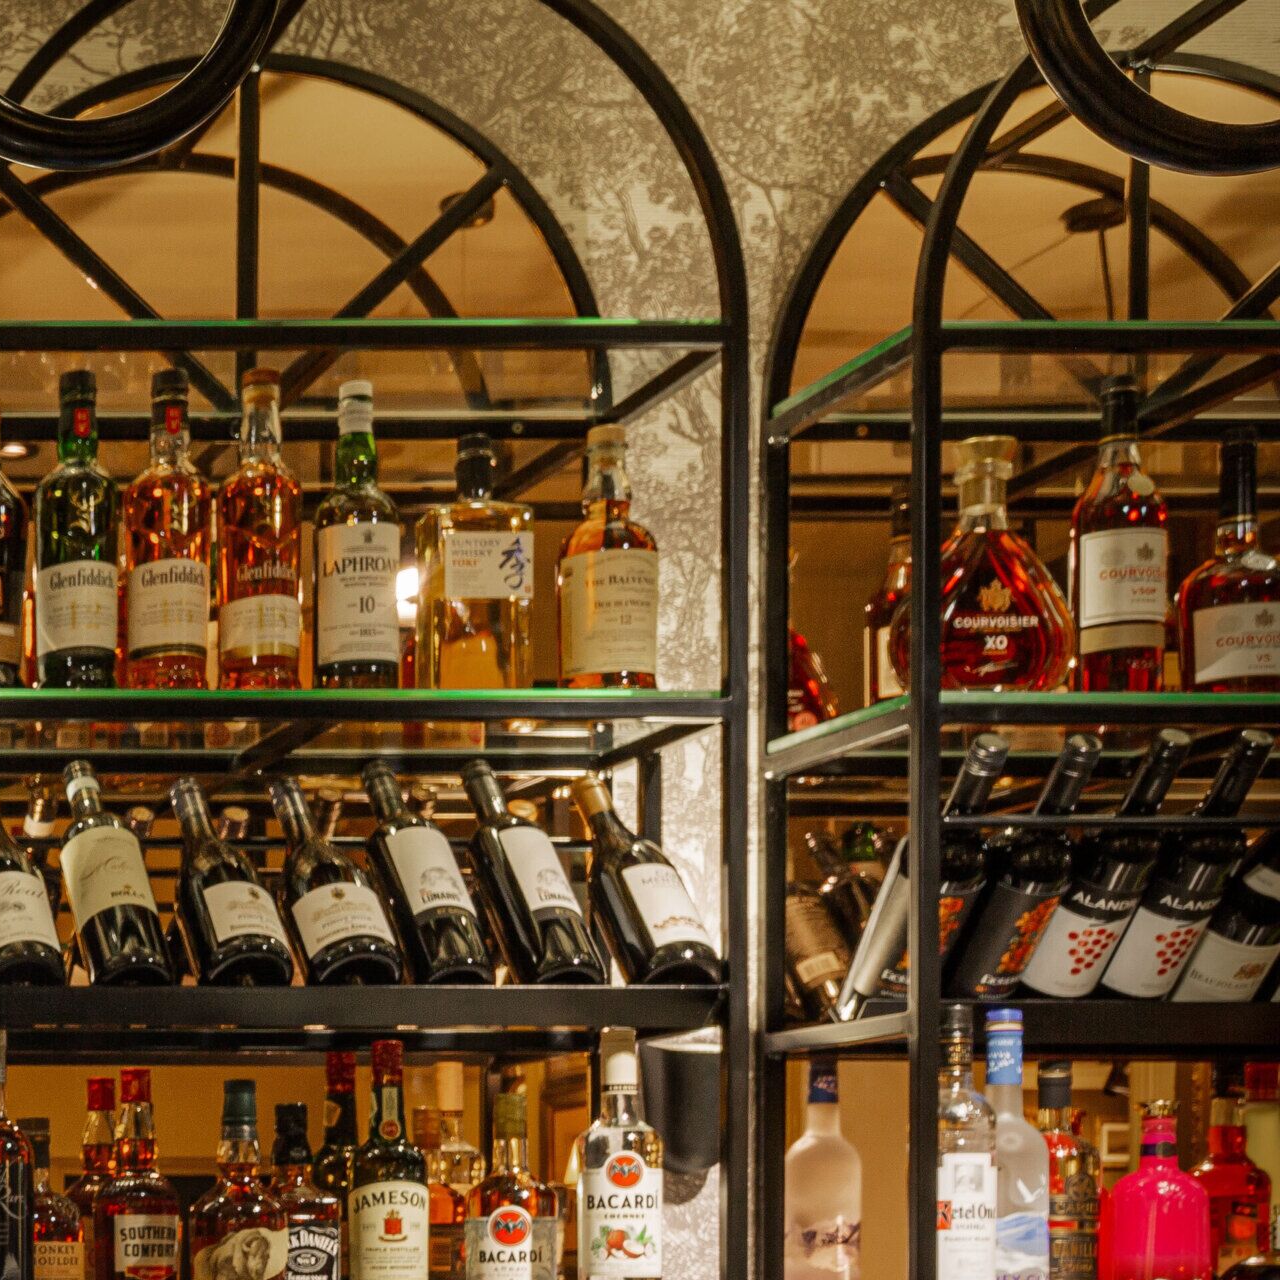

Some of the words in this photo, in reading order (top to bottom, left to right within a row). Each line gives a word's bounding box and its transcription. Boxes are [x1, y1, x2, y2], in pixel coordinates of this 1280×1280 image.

[359, 596, 375, 613] 10
[953, 616, 1039, 628] COURVOISIER
[984, 635, 1008, 650] XO
[1215, 635, 1280, 647] COURVOIS
[353, 1189, 426, 1214] JAMESON
[587, 1191, 659, 1210] BACARDÍ
[479, 1246, 542, 1263] BACARDÍ
